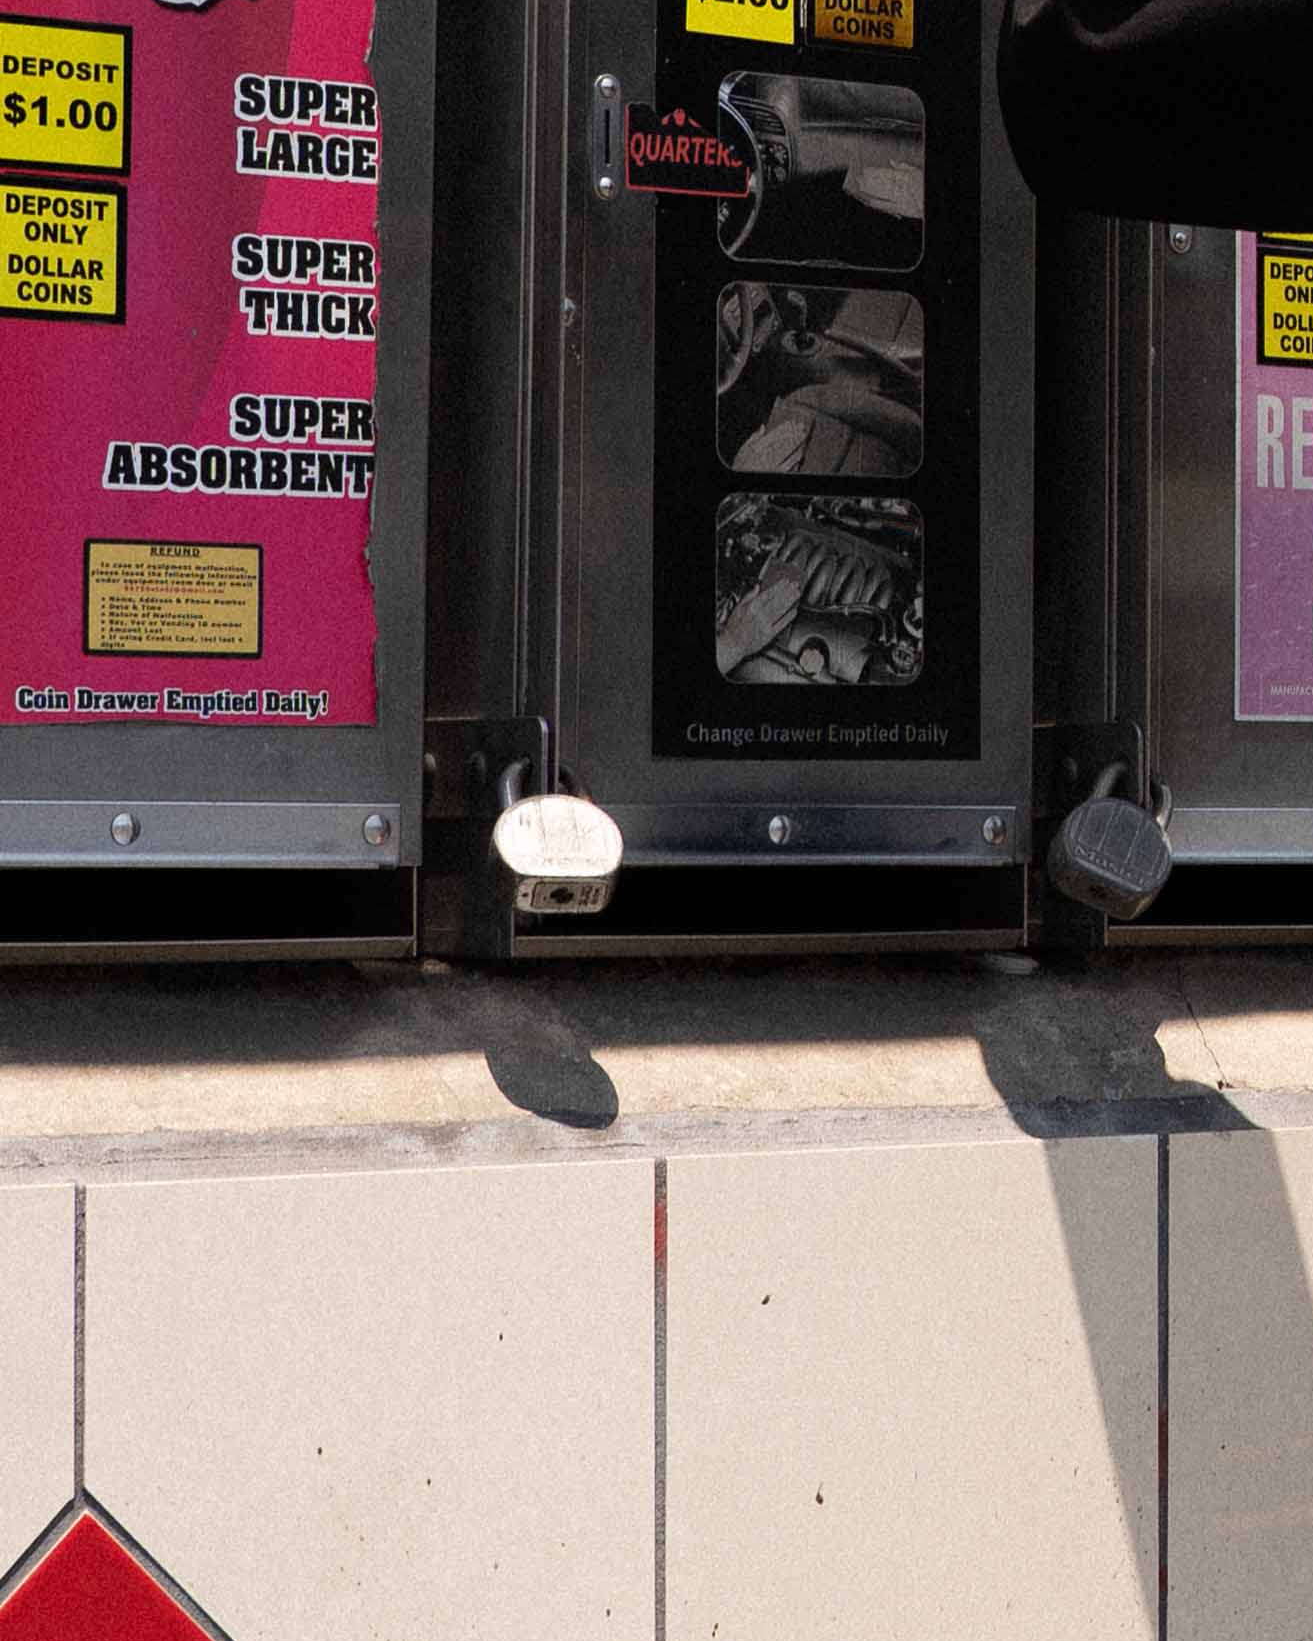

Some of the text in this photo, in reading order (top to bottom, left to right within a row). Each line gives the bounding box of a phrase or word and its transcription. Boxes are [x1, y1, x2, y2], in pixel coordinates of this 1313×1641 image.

[832, 15, 895, 40] COINS
[2, 54, 119, 83] DEPOSIT
[3, 92, 118, 132] $1.00
[239, 76, 377, 126] SUPER
[241, 130, 377, 179] LARGE
[5, 192, 109, 222] DEPOSIT
[24, 219, 88, 246] ONLY
[8, 254, 104, 281] DOLLAR
[236, 237, 375, 283] SUPER
[17, 278, 93, 306] COINS
[244, 290, 376, 336] THICK
[233, 396, 374, 440] SUPER
[106, 445, 374, 493] ABSORBENT
[150, 546, 200, 558] REFUND
[17, 687, 328, 716] Coin Drawer Emptied Daily!
[686, 723, 949, 747] Change Drawer Emptied Daily
